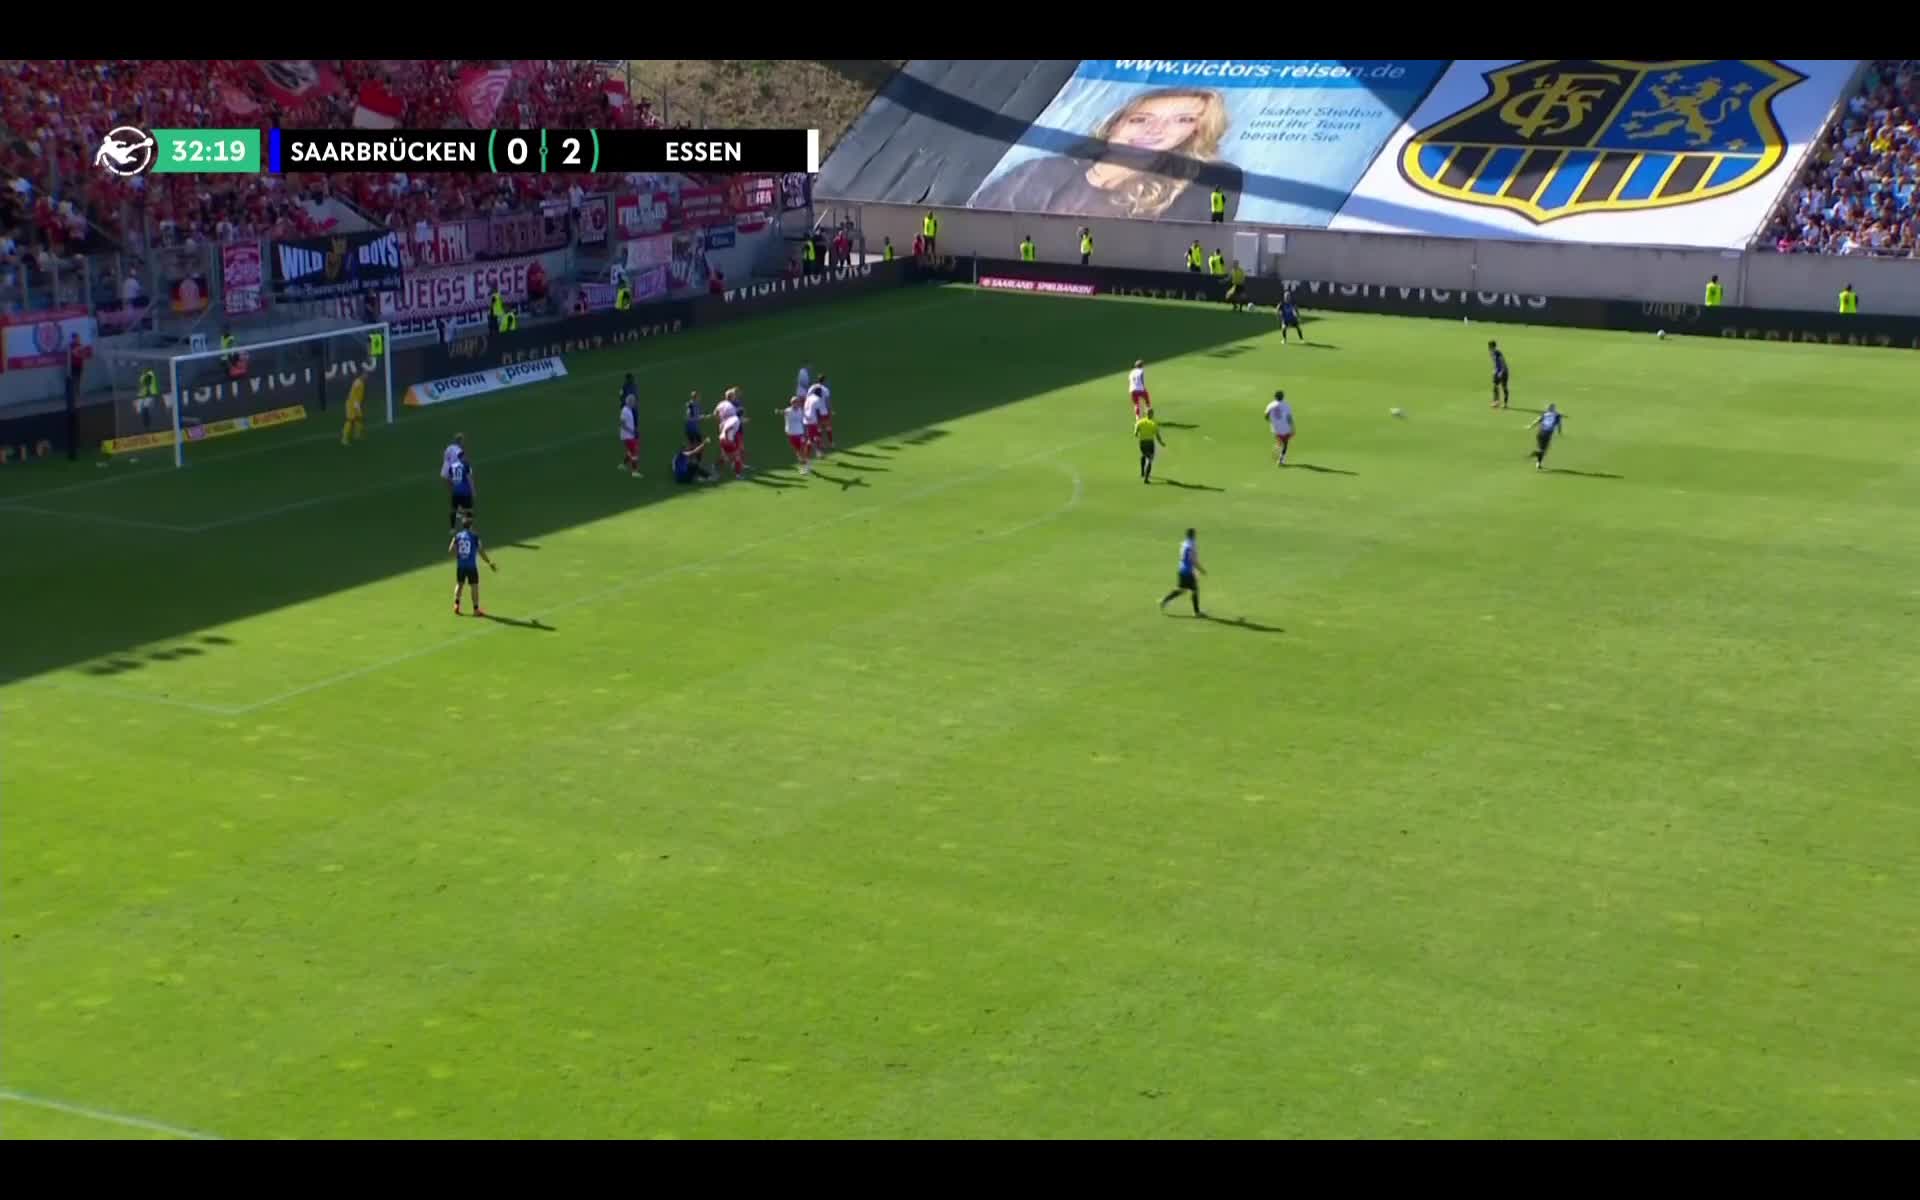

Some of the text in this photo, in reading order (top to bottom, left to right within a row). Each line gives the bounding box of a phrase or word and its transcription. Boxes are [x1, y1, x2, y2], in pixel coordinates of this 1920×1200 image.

[1114, 59, 1405, 79] www.victors-reisen.de
[1259, 106, 1384, 118] Isabel Shelton
[1316, 119, 1361, 130] Team
[1240, 130, 1306, 141] beraten
[278, 244, 324, 281] WILD
[359, 231, 399, 268] BOYS
